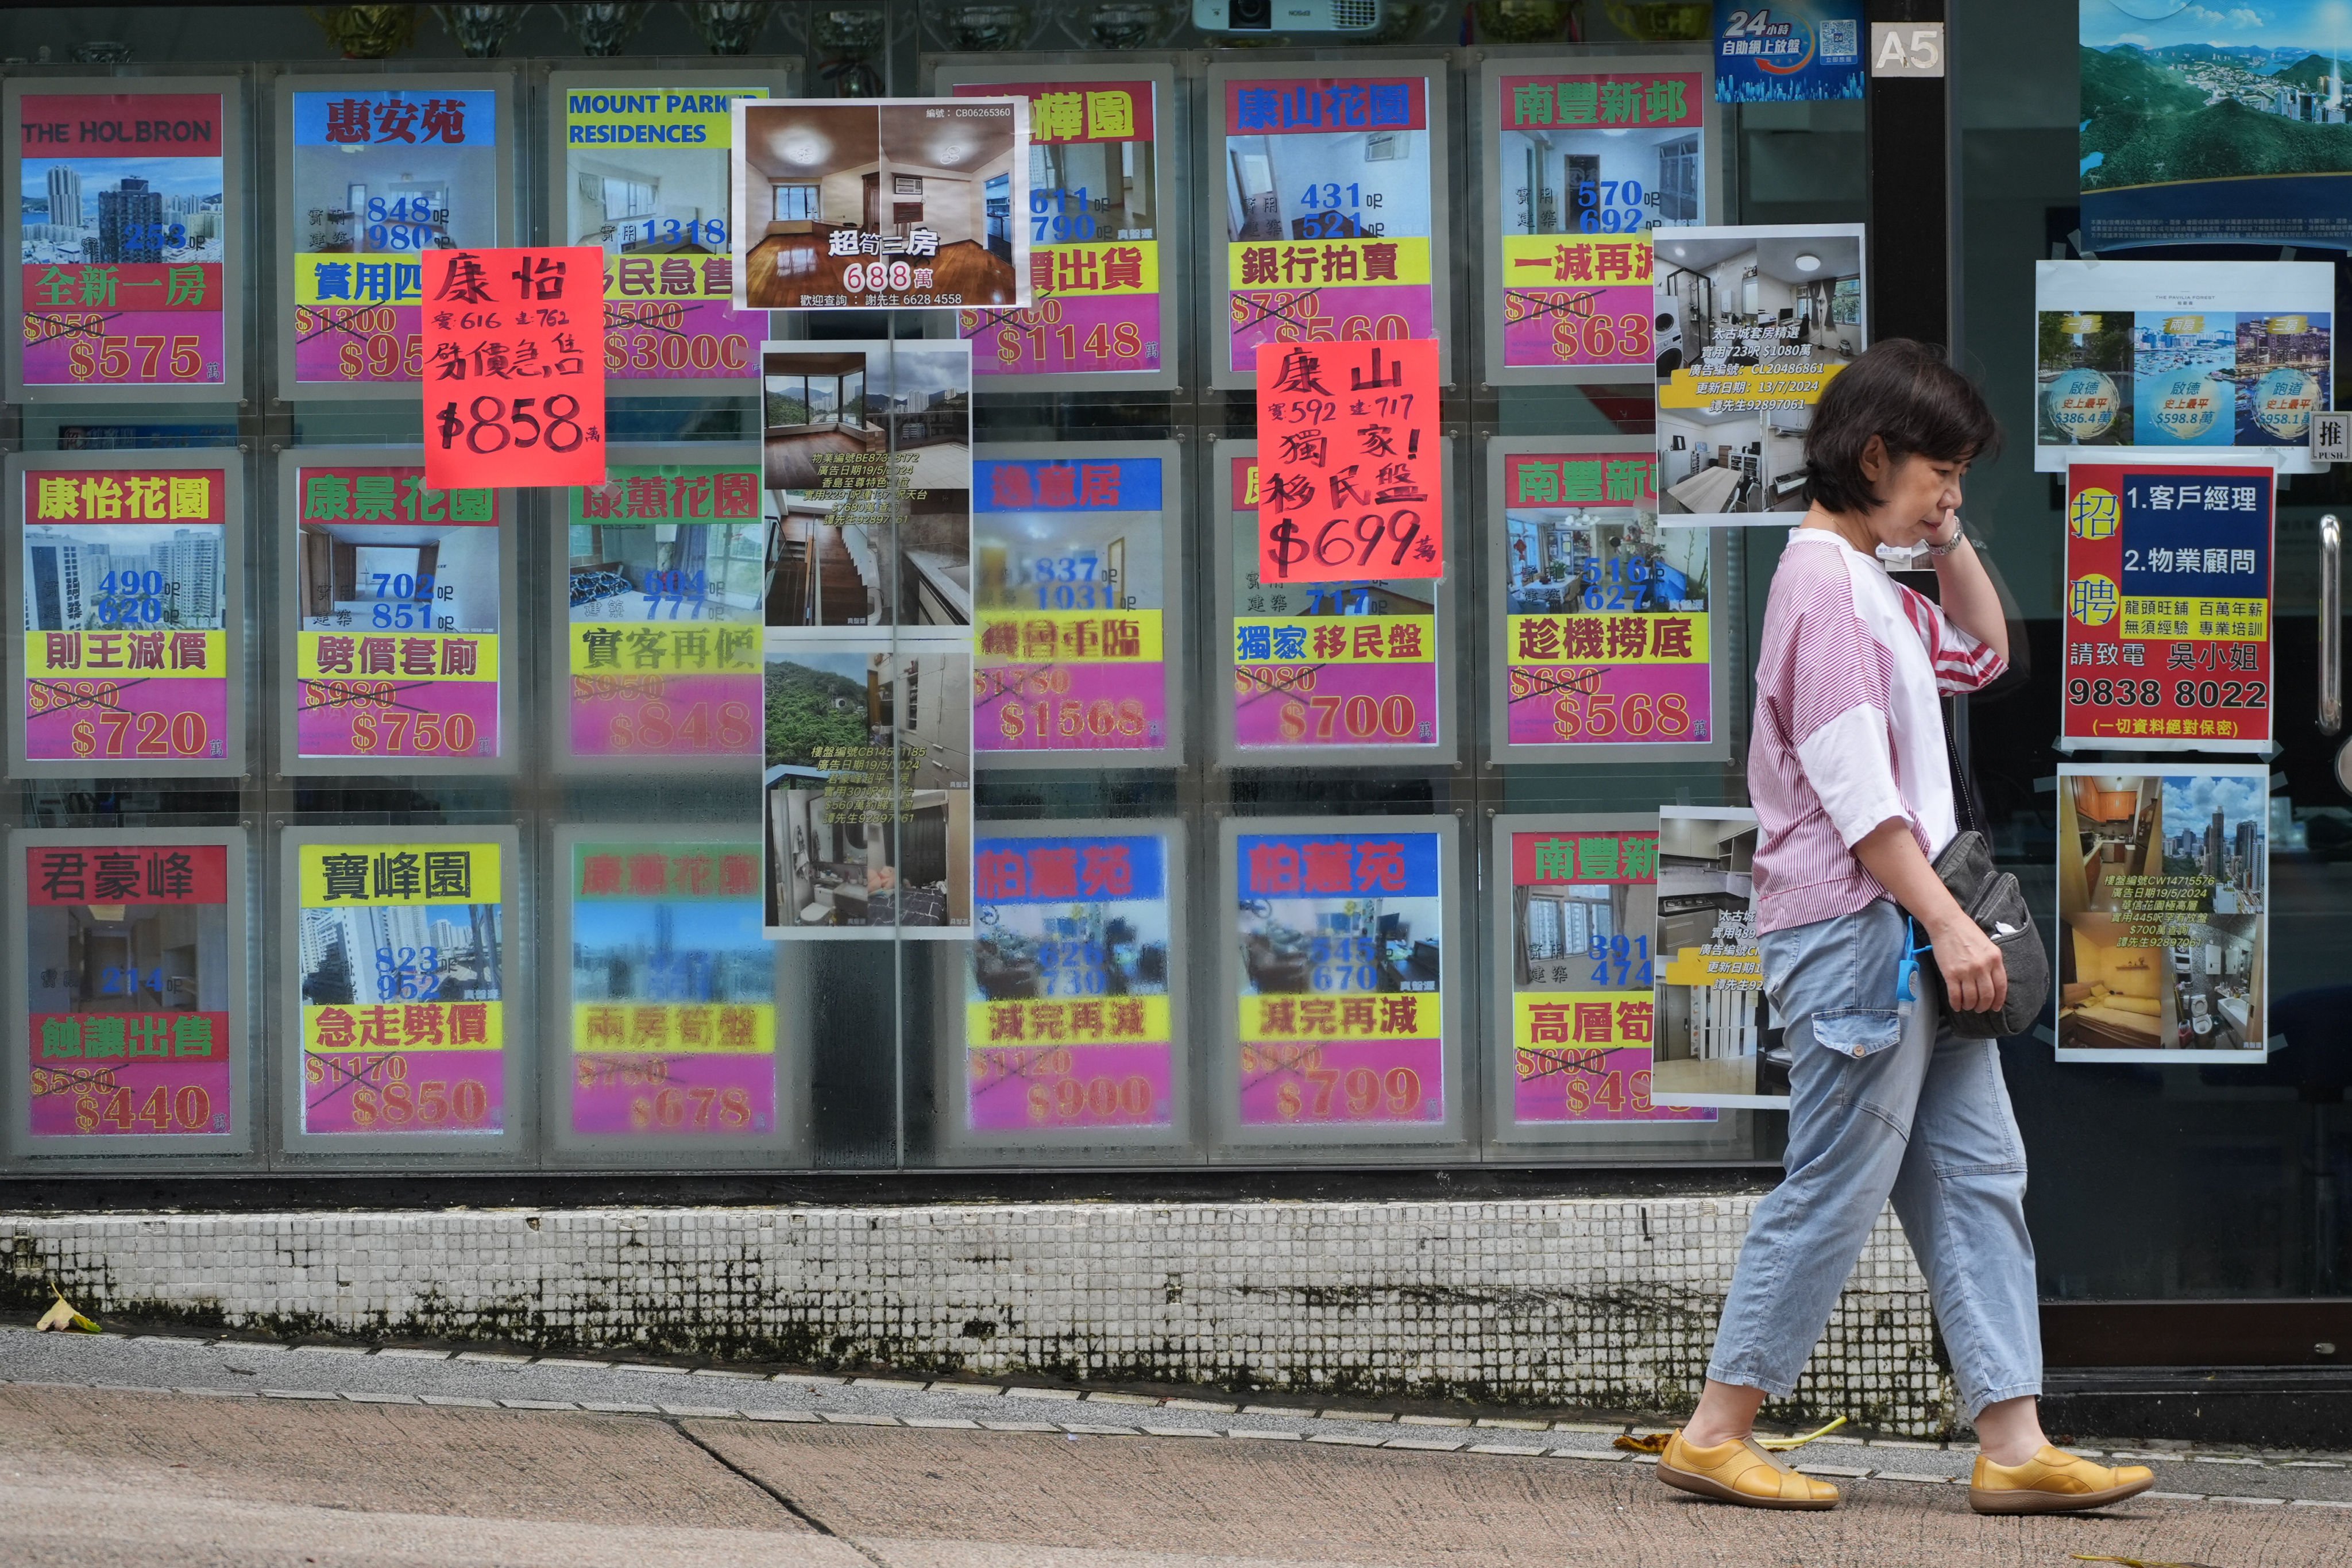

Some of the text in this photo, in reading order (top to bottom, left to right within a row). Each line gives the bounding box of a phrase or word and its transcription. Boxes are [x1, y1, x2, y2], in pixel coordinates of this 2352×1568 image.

[1722, 39, 1801, 55] 自助網上放盤
[1875, 31, 1938, 68] A5
[569, 95, 661, 113] MOUNT
[955, 108, 1011, 117] CB06265360
[1237, 84, 1411, 130] 康山花園
[1512, 80, 1687, 125] 南豐新邨
[22, 120, 211, 143] THE HOLBRON
[325, 98, 466, 144] 惠安苑
[569, 124, 706, 143] RESIDENCES
[828, 229, 939, 257] 超筍三房
[1241, 242, 1398, 285] 銀行拍賣
[36, 265, 207, 307] 全新一房
[433, 253, 566, 304] 康怡
[866, 294, 901, 306] 謝先生
[903, 294, 932, 305] 6628
[934, 293, 962, 304] 4558
[1712, 326, 1800, 340] 太古城套房精選
[2068, 318, 2092, 331] 一房
[2169, 318, 2195, 331] 兩房
[2272, 318, 2298, 331] 三房
[997, 321, 1142, 365] $1148
[1701, 345, 1761, 360] 實用723呎
[69, 335, 202, 381] $575
[1270, 347, 1402, 396] 康山
[1751, 362, 1825, 375] CL20486861
[1758, 379, 1820, 395] 13/7/2024
[2272, 381, 2304, 396] 跑道
[1709, 399, 1806, 413] 譚先生92897061
[2061, 397, 2108, 410] 史上最平
[2162, 398, 2210, 410] 史上最平
[2265, 399, 2312, 410] 史上最平
[2319, 420, 2342, 447] 推
[2318, 451, 2343, 459] PUSH
[38, 477, 211, 520] 康怡花園
[304, 474, 494, 522] 康景花園
[1261, 462, 1428, 515] 移民盤
[822, 515, 908, 526] 譚先生9289761
[2125, 600, 2263, 617] 龍頭旺舖 百萬年薪
[1518, 616, 1693, 660] 趁機撈底
[2124, 620, 2264, 636] 無須經驗 專業培訓
[46, 632, 207, 670] 則王減價
[317, 635, 478, 676] 劈價套廁
[2071, 642, 2259, 672] 請致電 吳小姐
[2068, 678, 2267, 709] 9838 8022
[610, 701, 754, 748] $848
[1001, 698, 1146, 740] $1568
[1281, 694, 1416, 739] $700
[1552, 693, 1690, 740] $568
[2092, 718, 2239, 738] (一切資料絕對保密)
[71, 712, 207, 758] $720
[352, 712, 476, 754] $750
[822, 813, 914, 824] 譚先生9289761
[41, 852, 194, 901] 君豪峰
[322, 851, 471, 901] 寶峰園
[2105, 875, 2216, 886] 樓盤編號CW14715576
[2111, 888, 2207, 899] 廣告日期19/5/2024
[2122, 900, 2198, 911] 華信花園極高層
[2111, 913, 2207, 924] 實用445呎罕有放盤
[1588, 934, 1648, 961] 391
[1710, 927, 1756, 940] 實用489
[2117, 937, 2202, 948] 譚先生92897061
[315, 1002, 488, 1048] 急走劈價
[1528, 1001, 1654, 1044] 高層筍
[41, 1015, 213, 1059] 蝕讓出售
[353, 1079, 488, 1127] $850
[1277, 1067, 1421, 1118] $799
[75, 1086, 211, 1133] $440
